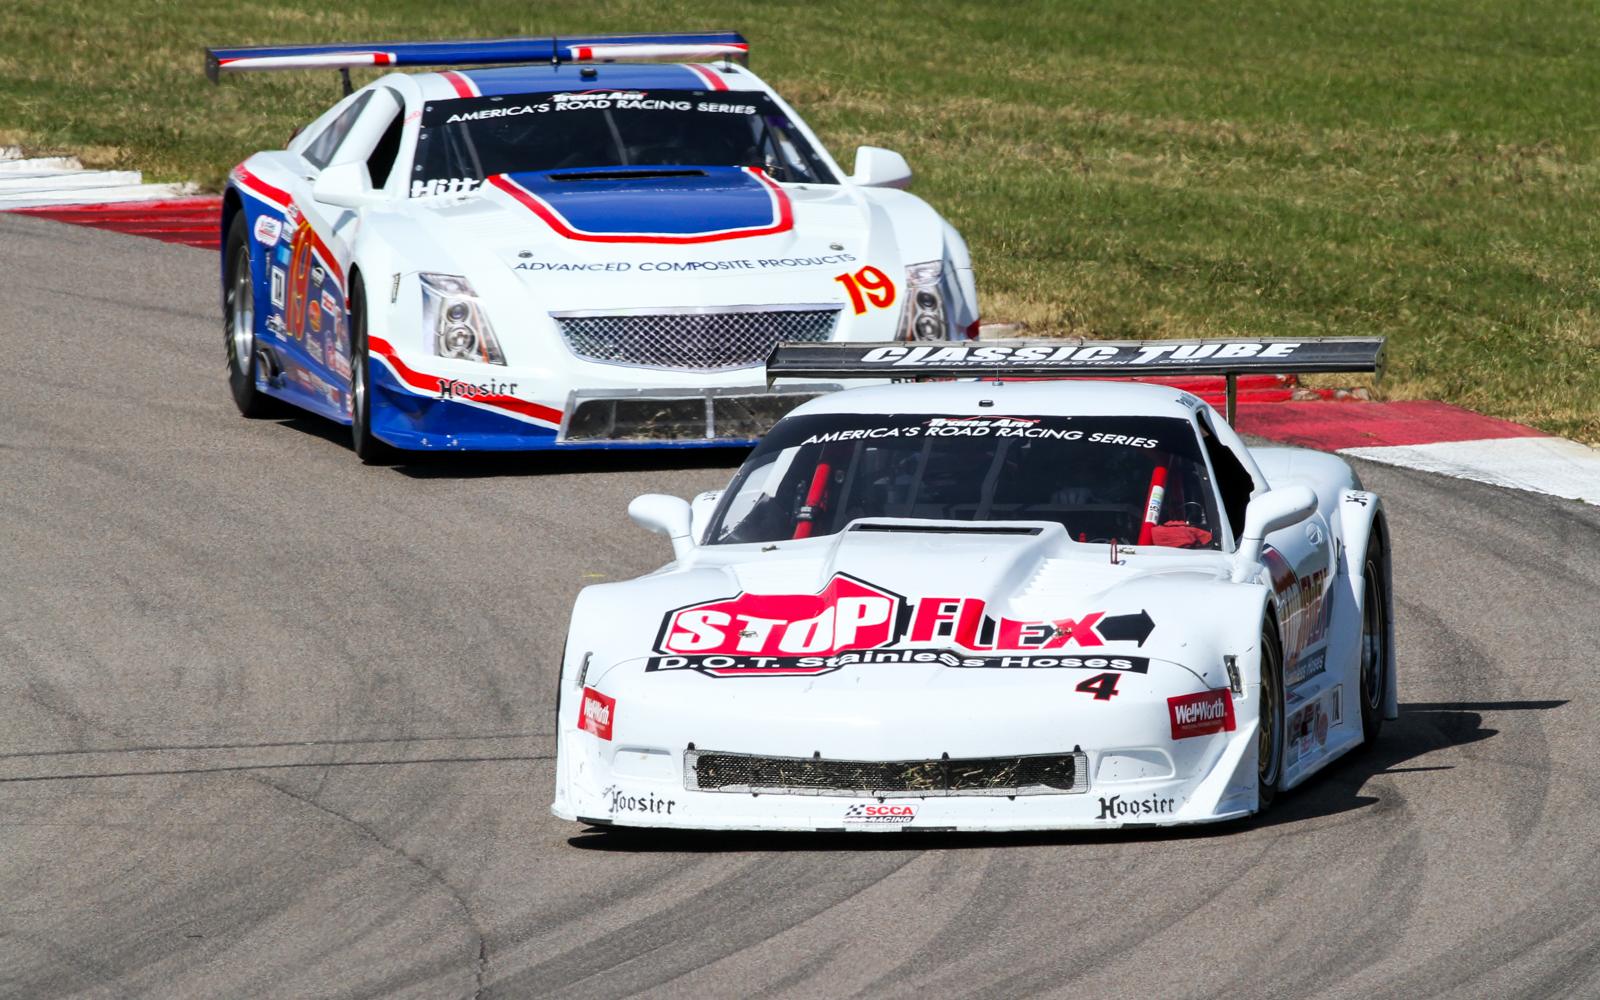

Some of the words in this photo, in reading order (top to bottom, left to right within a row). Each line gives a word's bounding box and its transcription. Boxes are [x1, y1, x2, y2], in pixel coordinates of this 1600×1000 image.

[446, 103, 550, 123] AMERICA'S
[555, 99, 612, 112] ROAD
[616, 100, 692, 111] RACING
[697, 102, 756, 115] SERIES
[514, 262, 632, 272] ADVANCED
[639, 259, 755, 272] COMPOSITE
[758, 254, 857, 268] PRODUCTS
[834, 265, 896, 315] 19
[861, 346, 1120, 366] CLASSIC
[1130, 343, 1301, 364] TUBE
[436, 378, 518, 400] Hoosier
[801, 425, 918, 445] AMERICA'S
[924, 426, 991, 437] ROAD
[995, 427, 1083, 442] RACING
[1088, 432, 1159, 449] SERIES
[668, 596, 890, 654] STOP
[909, 597, 1106, 651] FLEX
[658, 656, 780, 669] D.O.T.
[796, 649, 986, 669] Stainless
[1000, 656, 1134, 670] Hoses
[1075, 673, 1121, 701] 4
[607, 790, 676, 815] Hoosier
[865, 806, 913, 816] SCCA
[1096, 793, 1175, 820] Hoosier
